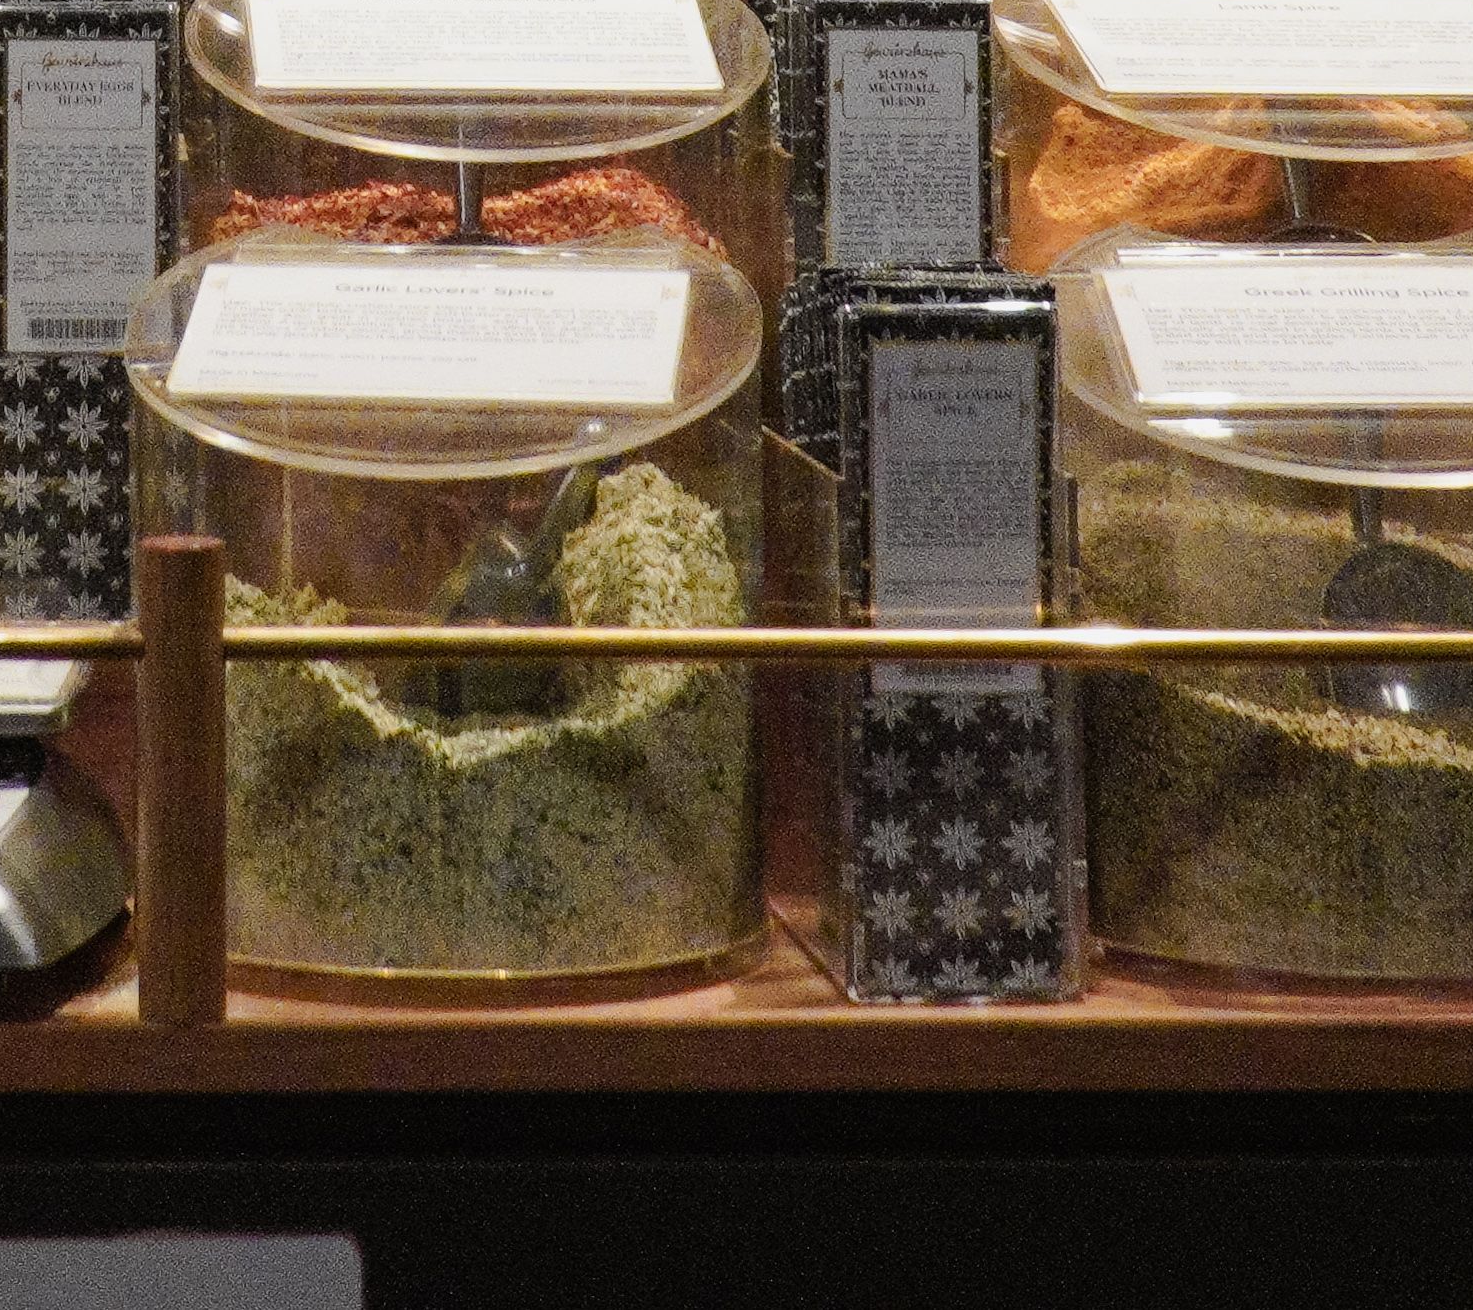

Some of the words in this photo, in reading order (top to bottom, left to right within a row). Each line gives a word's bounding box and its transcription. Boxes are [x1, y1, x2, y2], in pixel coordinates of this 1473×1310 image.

[1217, 2, 1278, 12] Lamb
[1283, 2, 1341, 13] Spice
[334, 283, 398, 294] Garlic
[493, 286, 554, 299] Spice
[1243, 286, 1313, 298] Greek
[1319, 286, 1401, 301] Grilling
[1406, 286, 1471, 300] Spice
